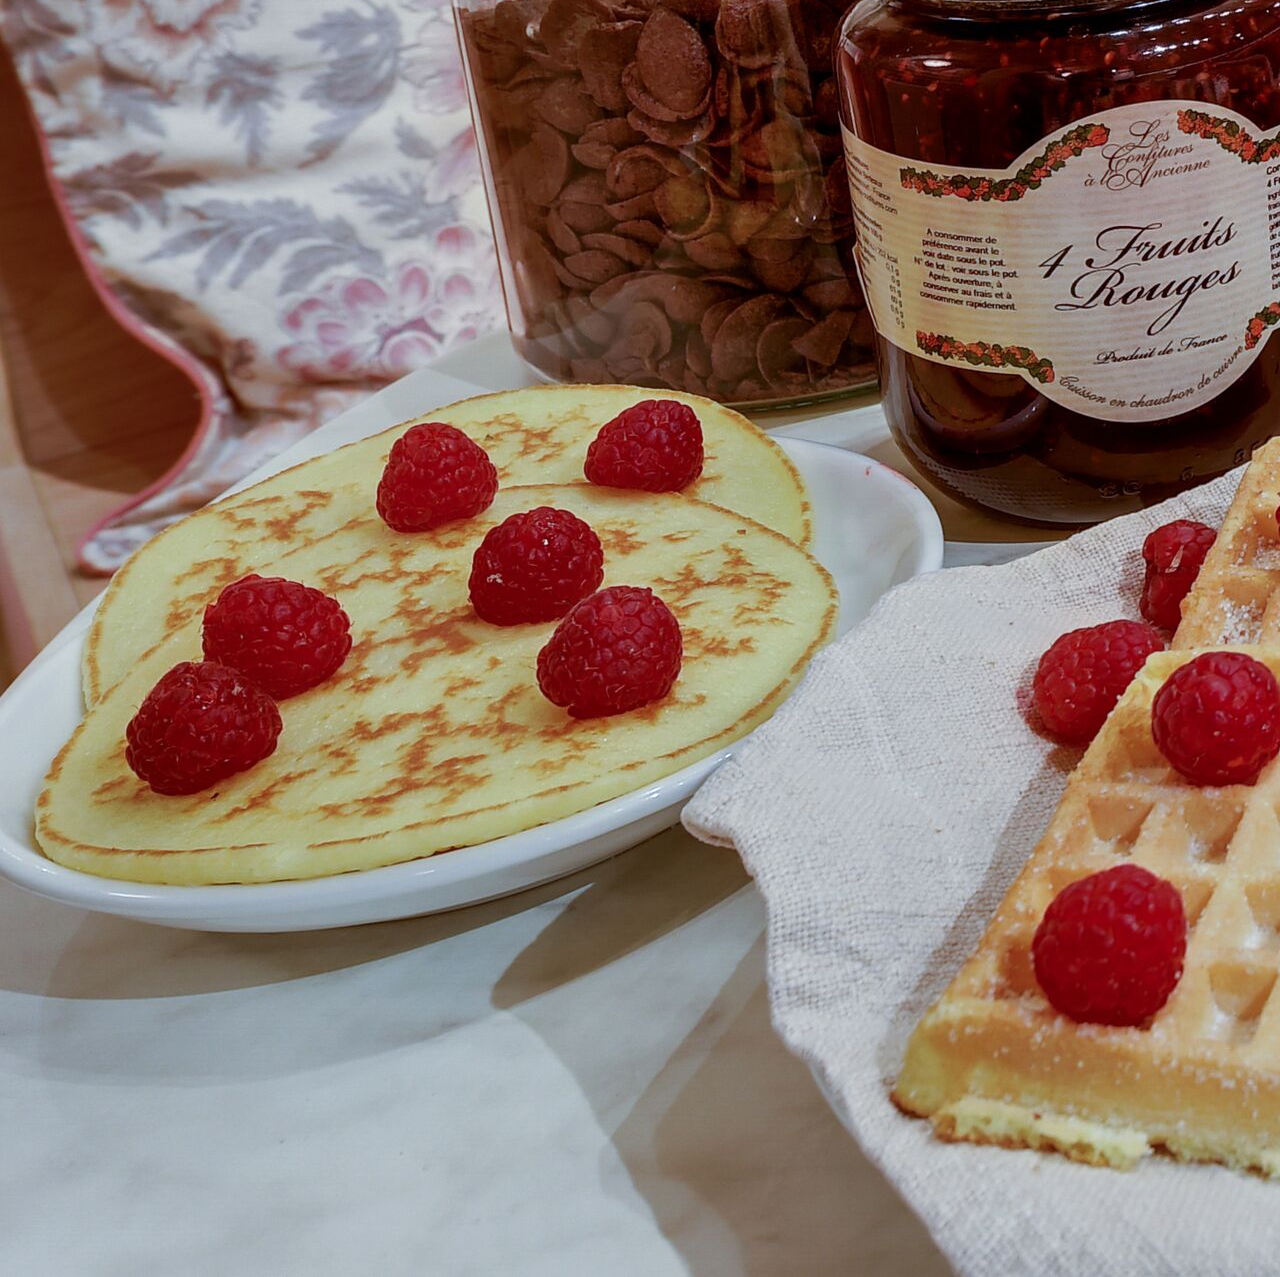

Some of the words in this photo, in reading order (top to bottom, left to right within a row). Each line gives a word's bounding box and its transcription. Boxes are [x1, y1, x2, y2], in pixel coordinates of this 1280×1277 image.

[1129, 119, 1170, 149] Les
[934, 231, 982, 243] consommer
[985, 236, 996, 244] de
[922, 239, 963, 252] préférence
[965, 246, 989, 254] avant
[1039, 244, 1073, 278] 4
[1086, 216, 1238, 269] Fruits
[922, 250, 935, 258] voir
[937, 252, 954, 261] date
[979, 258, 986, 266] le
[925, 260, 934, 268] de
[952, 266, 966, 274] voir
[992, 269, 1000, 277] le
[929, 271, 950, 282] Après
[952, 277, 993, 288] ouverture,
[920, 291, 963, 305] consommer
[923, 282, 959, 294] conserver
[961, 288, 971, 296] au
[974, 289, 992, 298] frais
[1054, 261, 1242, 336] Rouges
[1092, 347, 1155, 364] Produit
[1158, 341, 1173, 356] de
[1178, 335, 1227, 352] France
[1059, 376, 1106, 403] Cuisson
[1110, 398, 1126, 407] en
[1130, 389, 1194, 407] chaudron
[1197, 374, 1211, 390] de
[1213, 345, 1243, 379] cuivre
